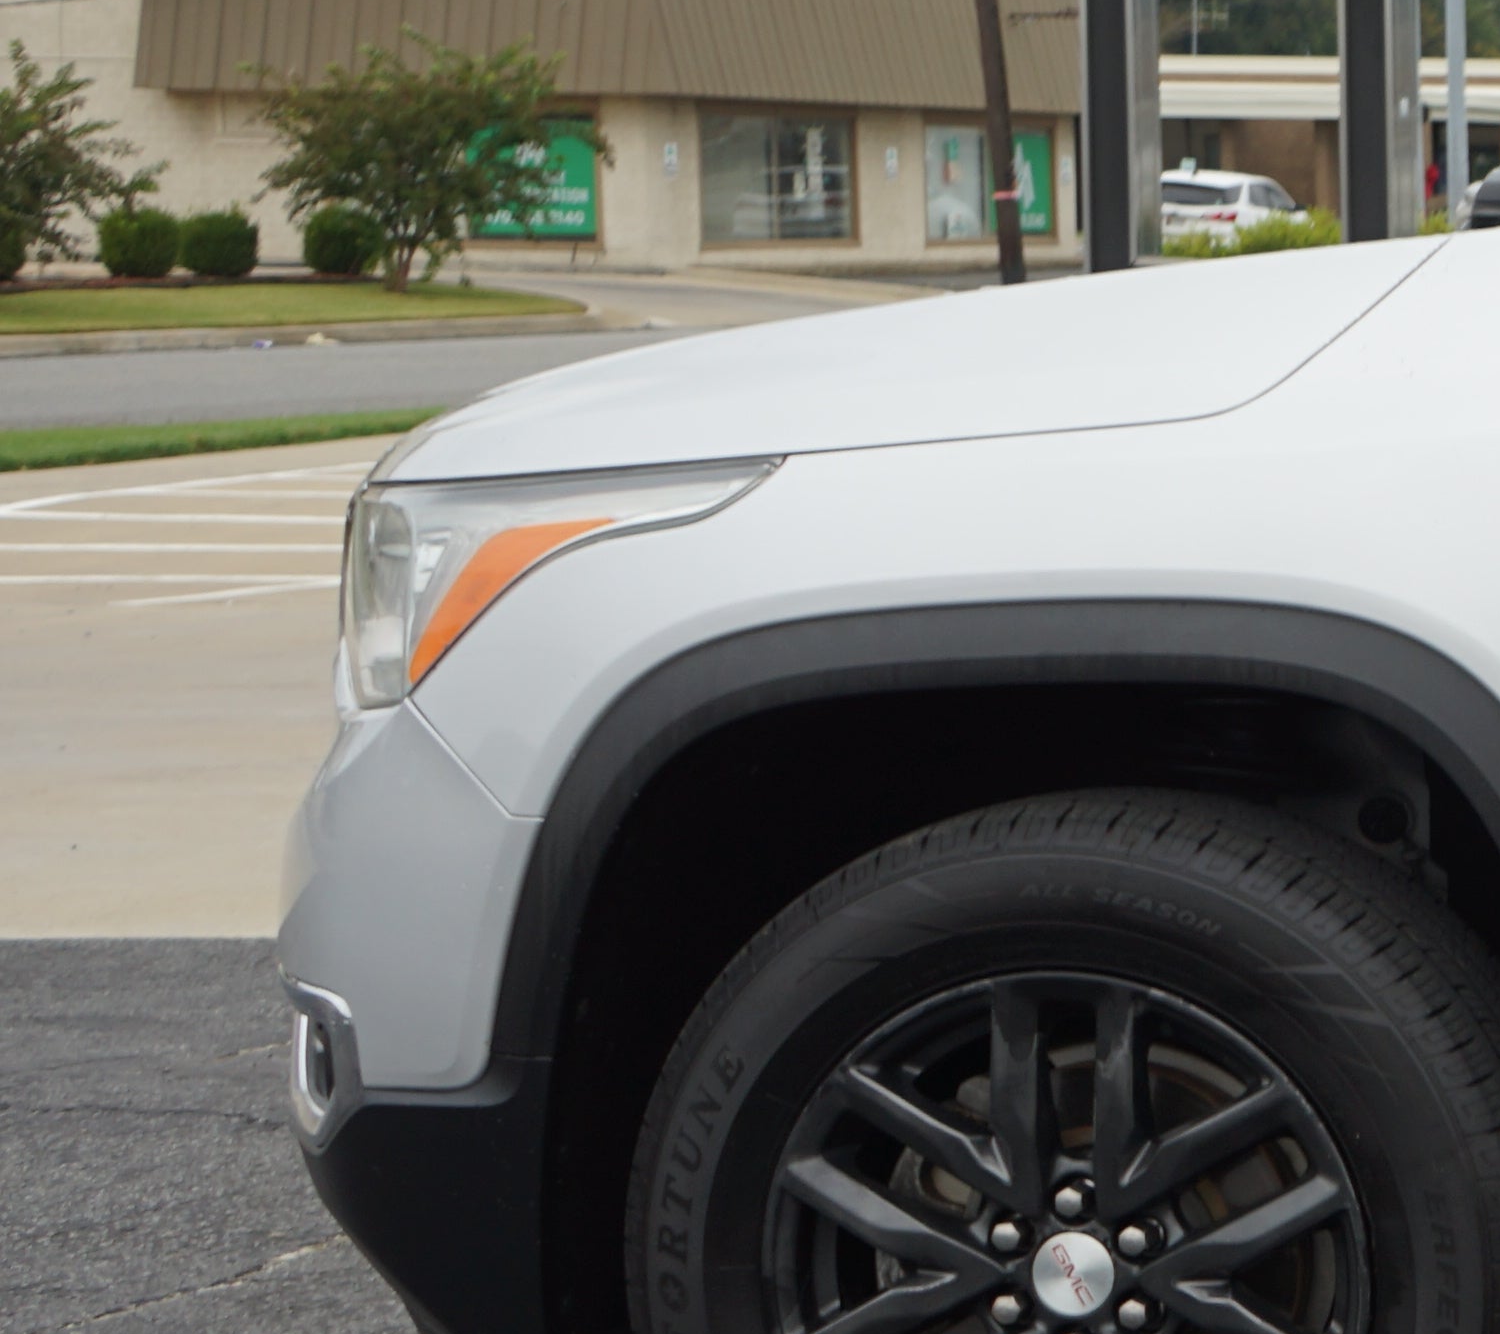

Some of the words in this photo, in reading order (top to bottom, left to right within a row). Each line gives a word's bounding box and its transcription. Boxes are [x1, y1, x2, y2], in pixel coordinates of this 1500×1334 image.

[1019, 883, 1074, 899] ALL
[1093, 887, 1222, 936] SEASON
[1051, 1243, 1095, 1308] GMC
